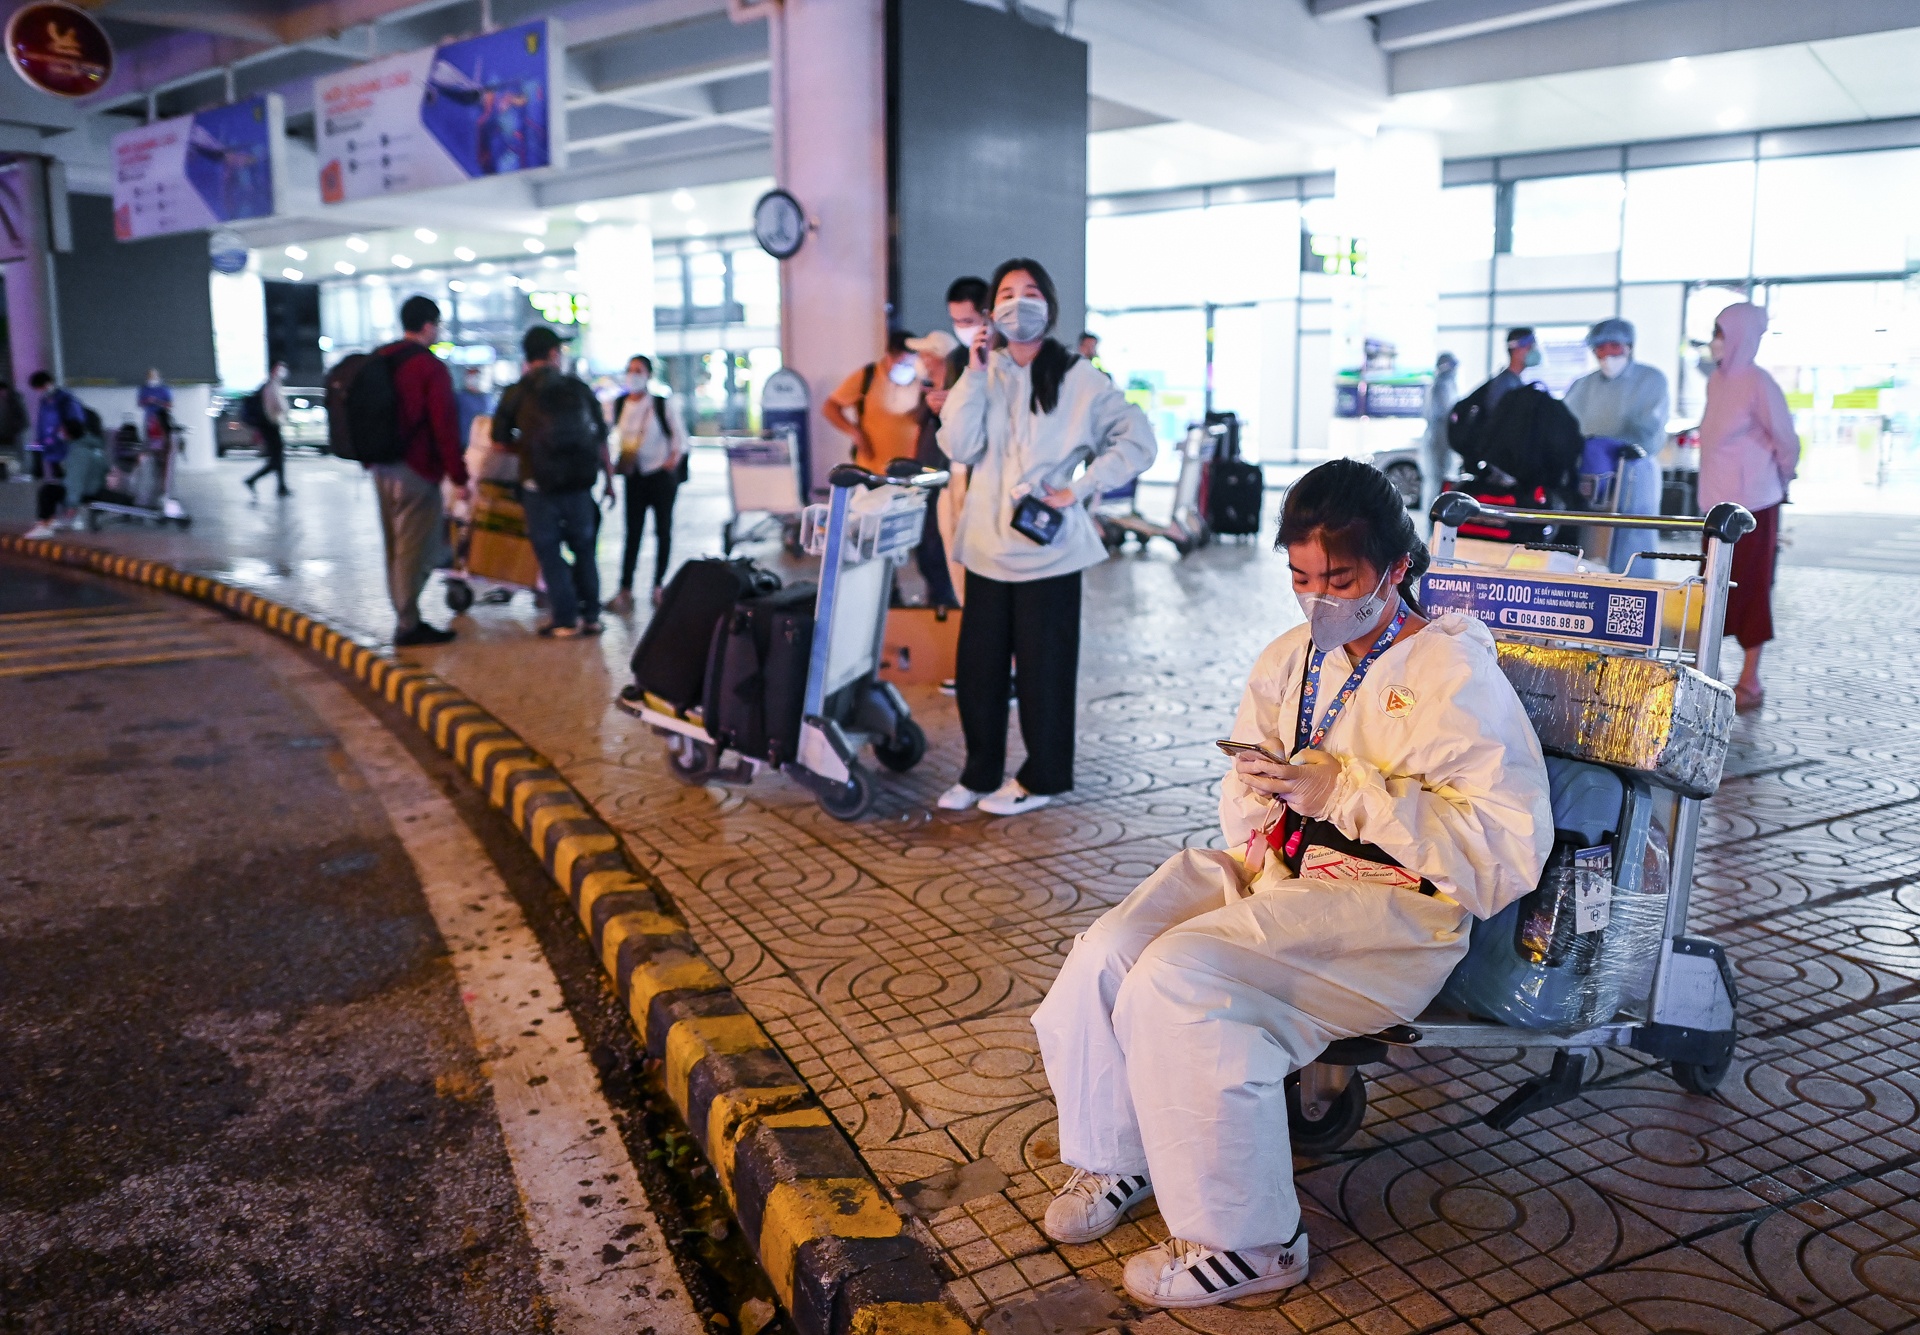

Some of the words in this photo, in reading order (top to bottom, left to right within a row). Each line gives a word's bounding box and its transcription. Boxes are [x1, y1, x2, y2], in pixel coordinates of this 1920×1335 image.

[1428, 579, 1471, 592] BIZMAN
[1488, 583, 1531, 604] 20.000
[1480, 609, 1496, 620] CÁO
[1520, 613, 1586, 630] 094.986.98.98
